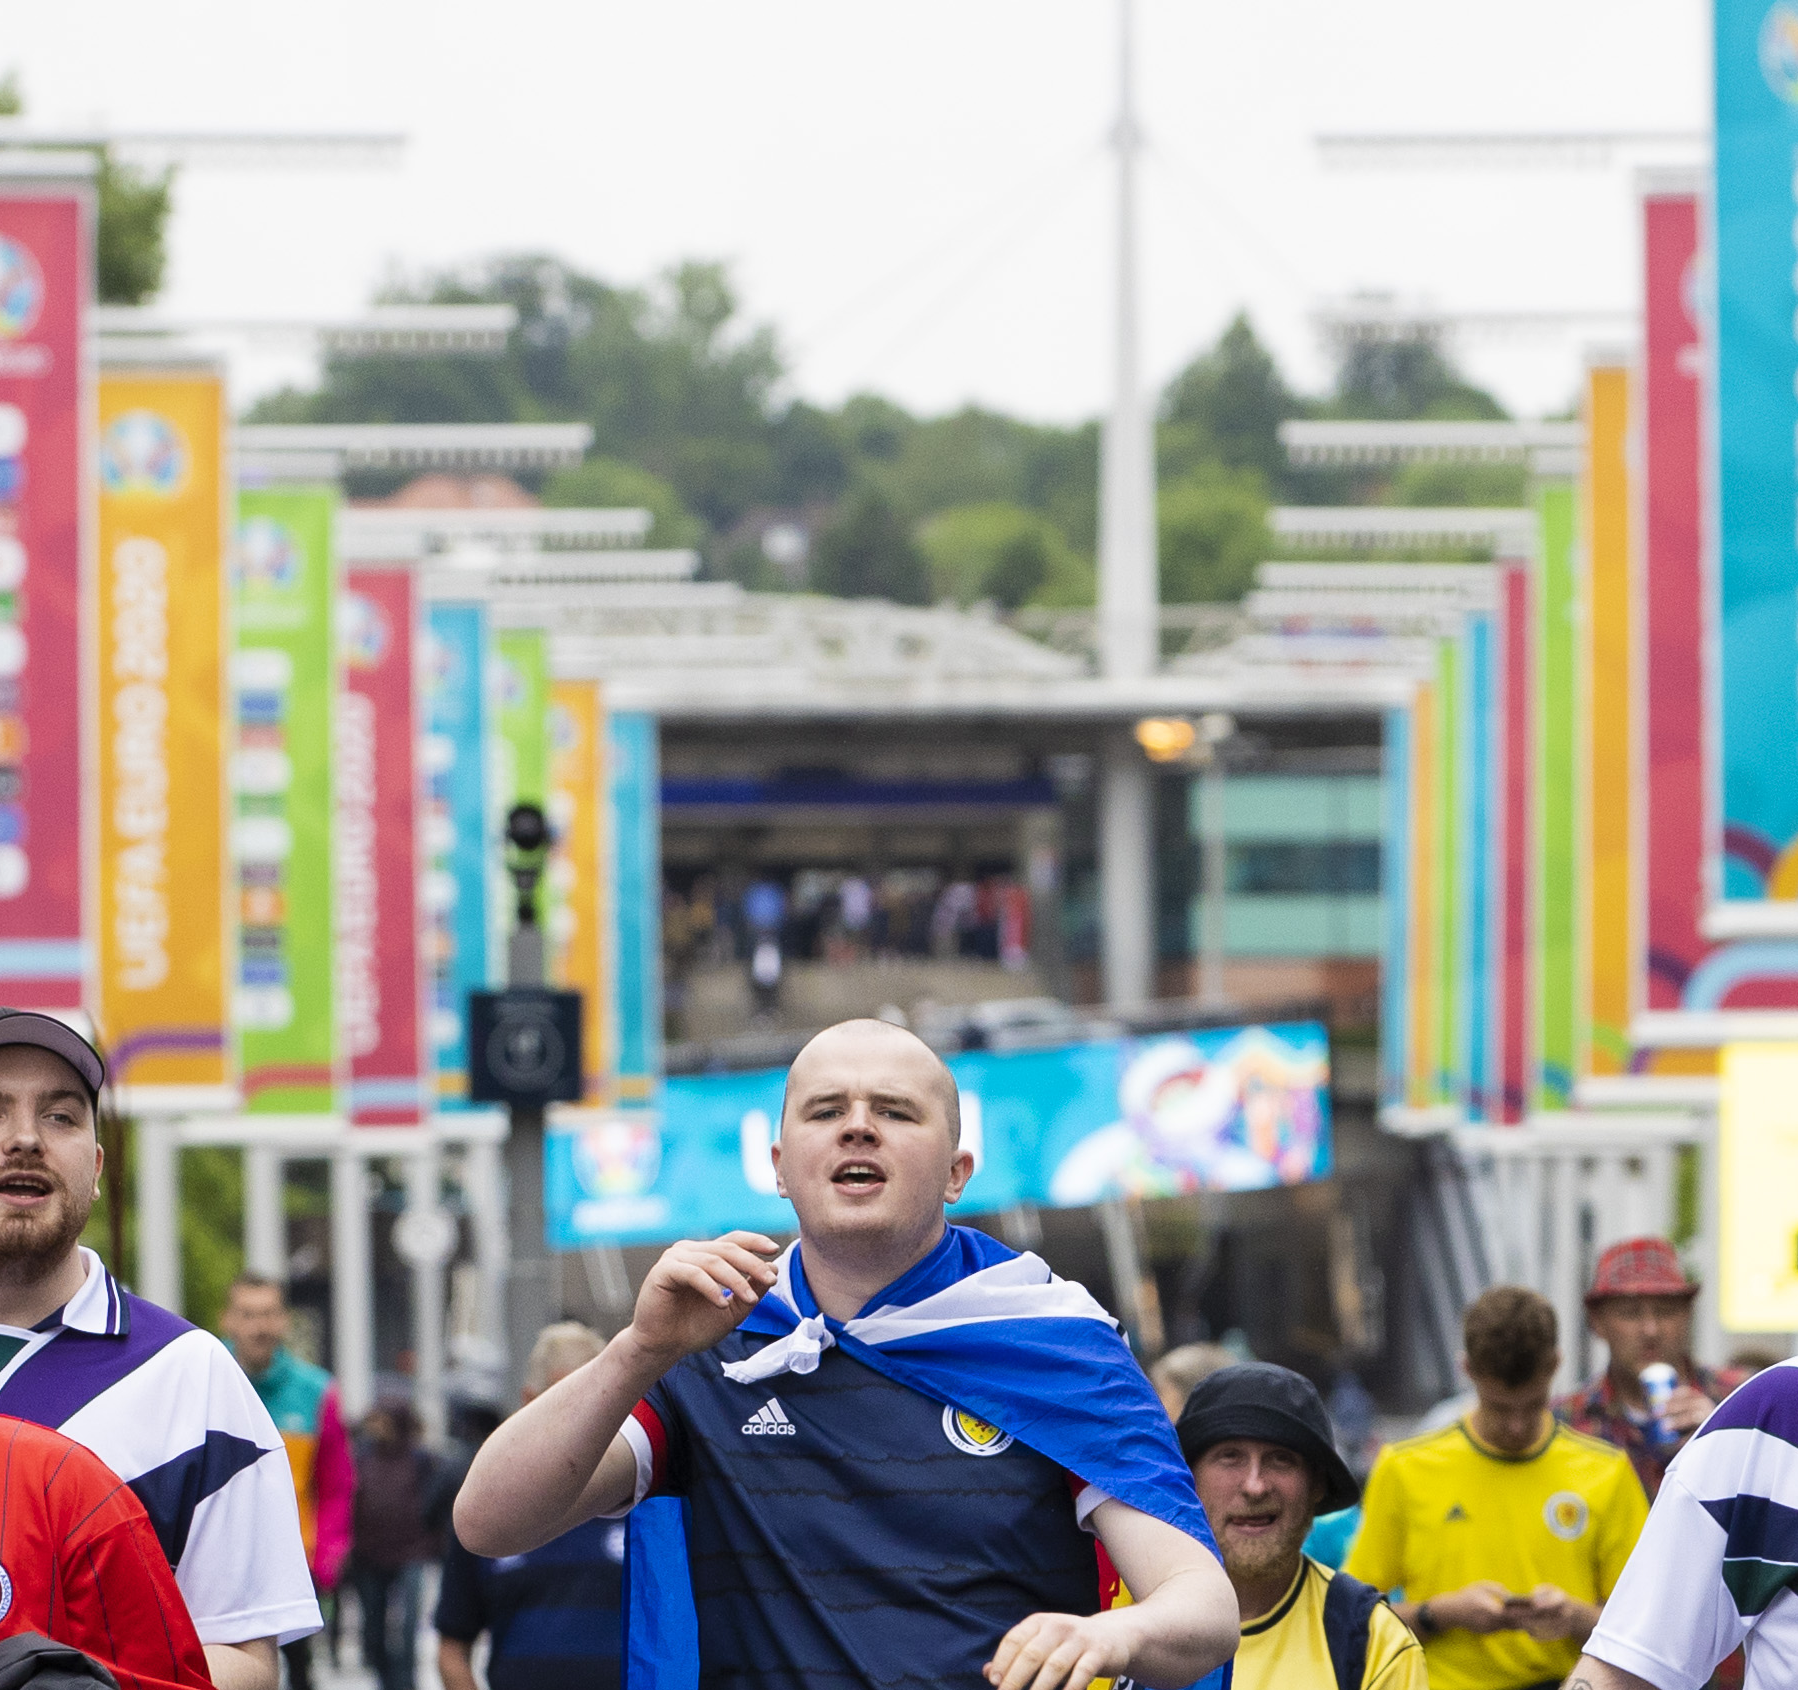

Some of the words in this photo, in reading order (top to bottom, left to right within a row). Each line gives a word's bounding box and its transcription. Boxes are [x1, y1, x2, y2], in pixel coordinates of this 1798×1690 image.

[113, 682, 169, 840] EURO
[113, 838, 169, 991] UEFA
[741, 1421, 797, 1436] adidas
